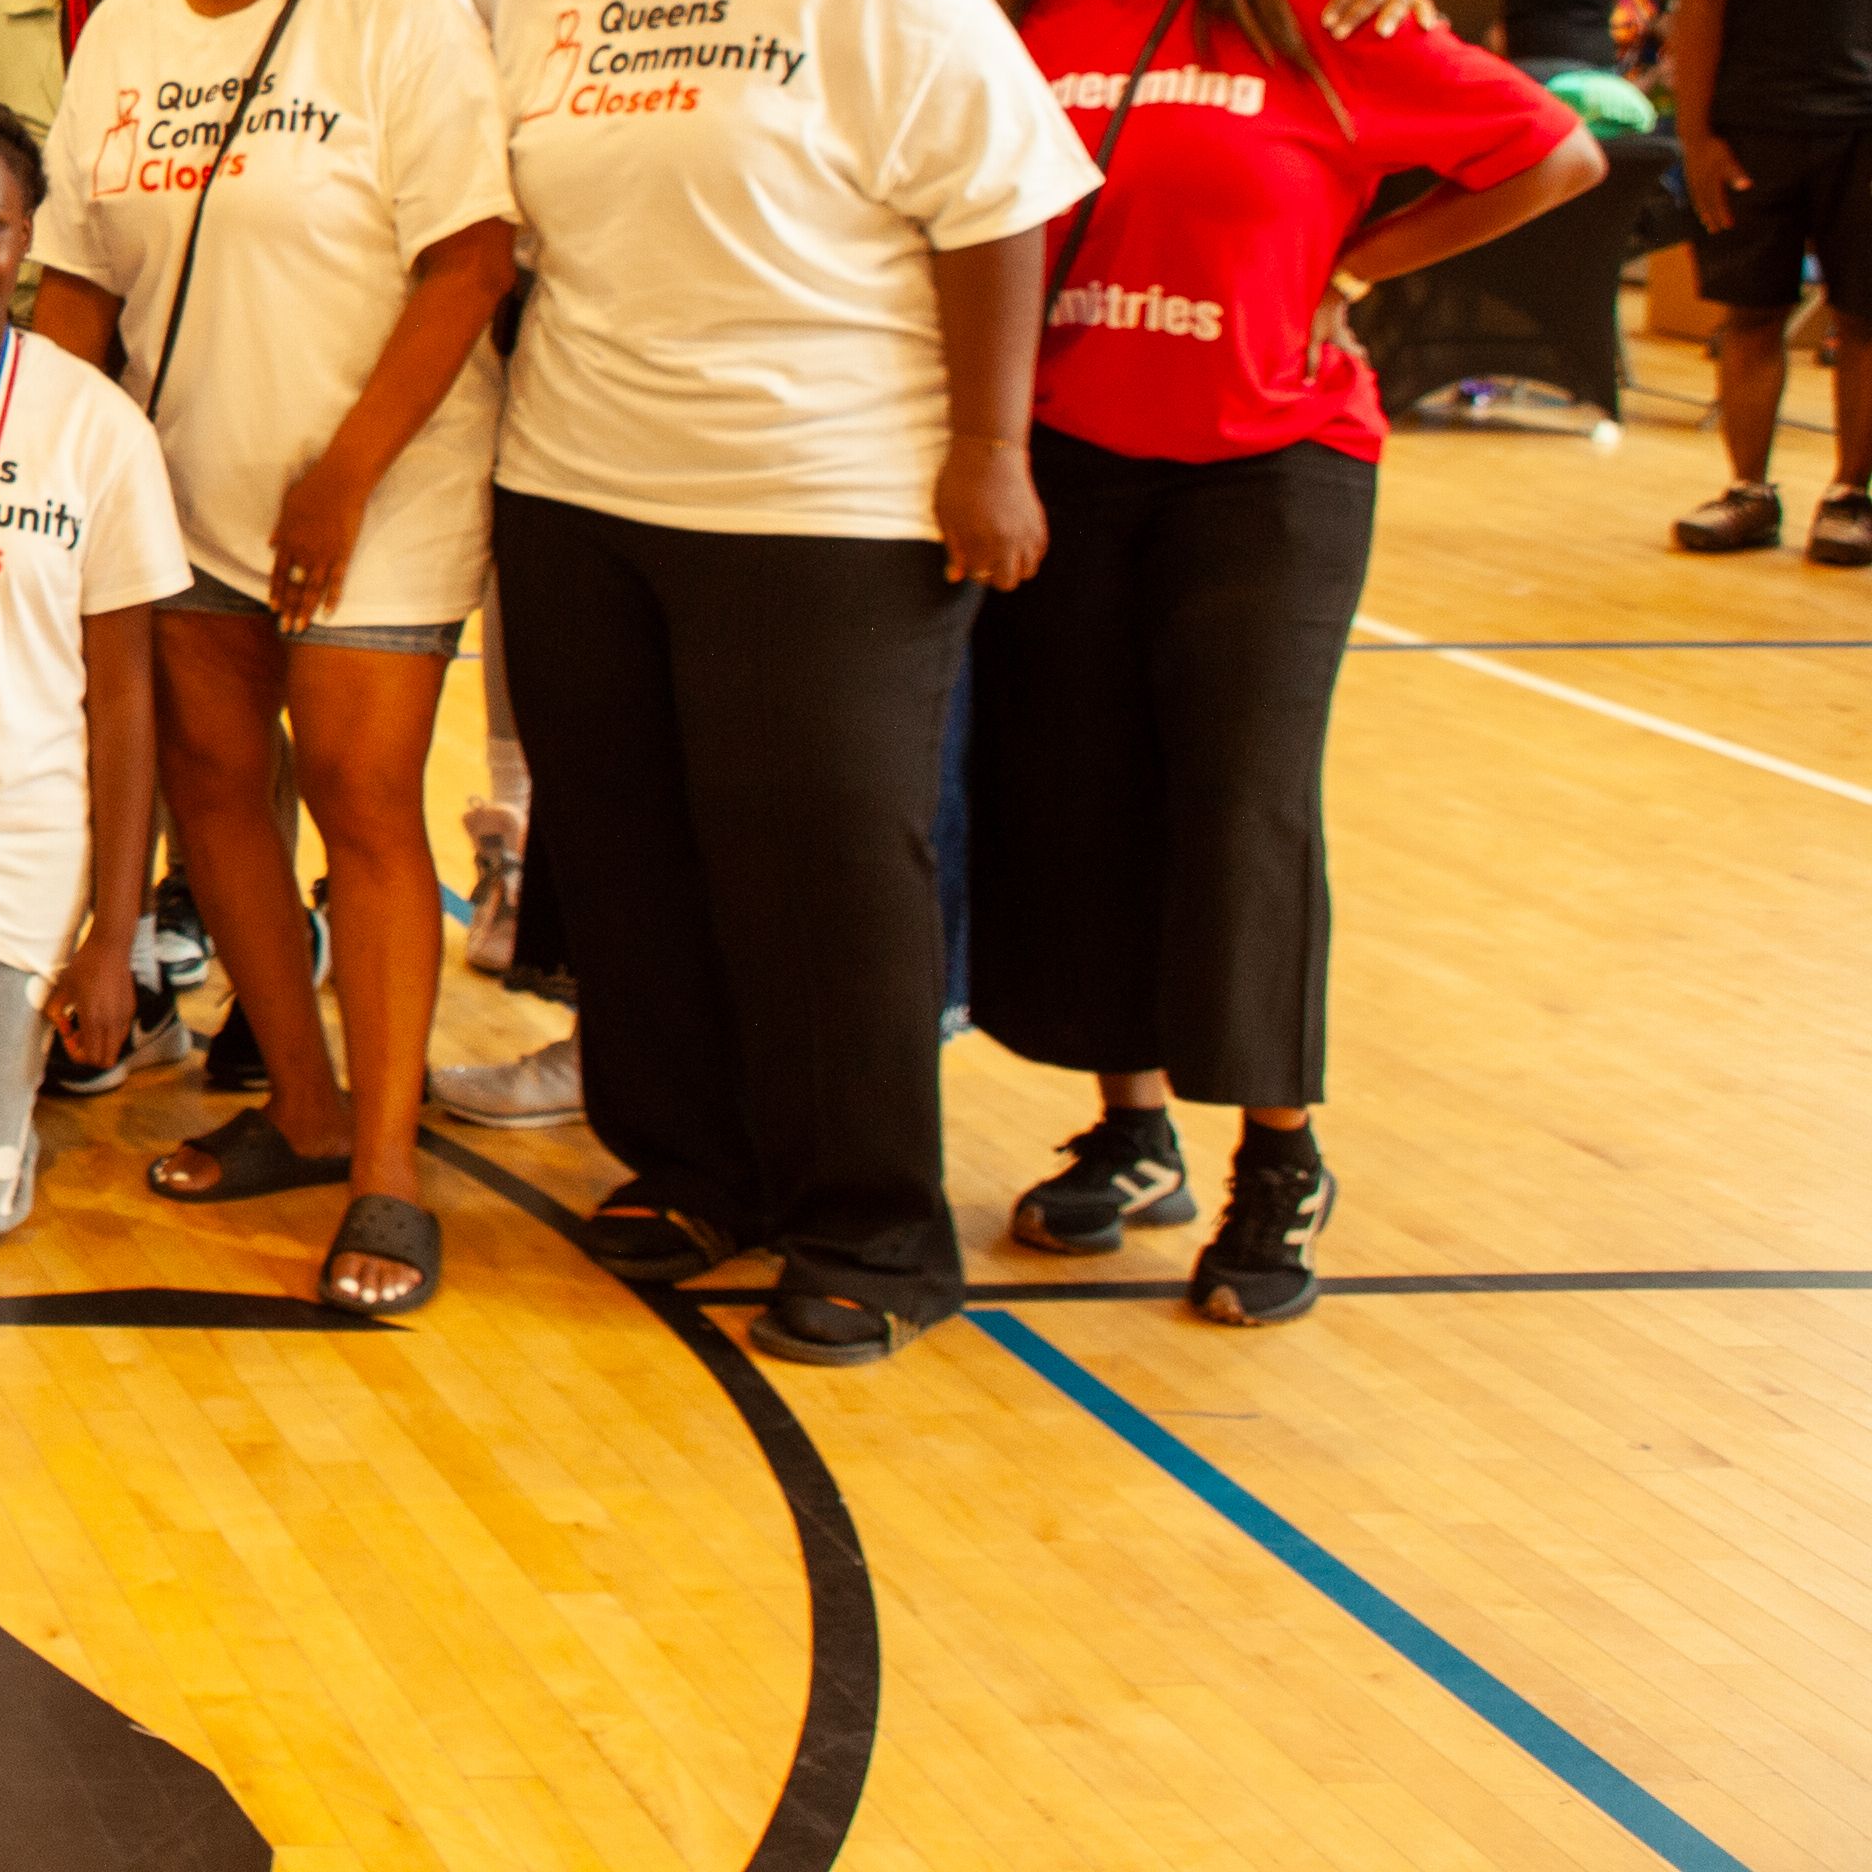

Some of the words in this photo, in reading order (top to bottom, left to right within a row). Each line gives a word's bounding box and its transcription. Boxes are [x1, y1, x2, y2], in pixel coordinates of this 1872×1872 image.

[600, 0, 729, 34] Queens
[588, 34, 807, 86] Community
[570, 79, 701, 117] Closets
